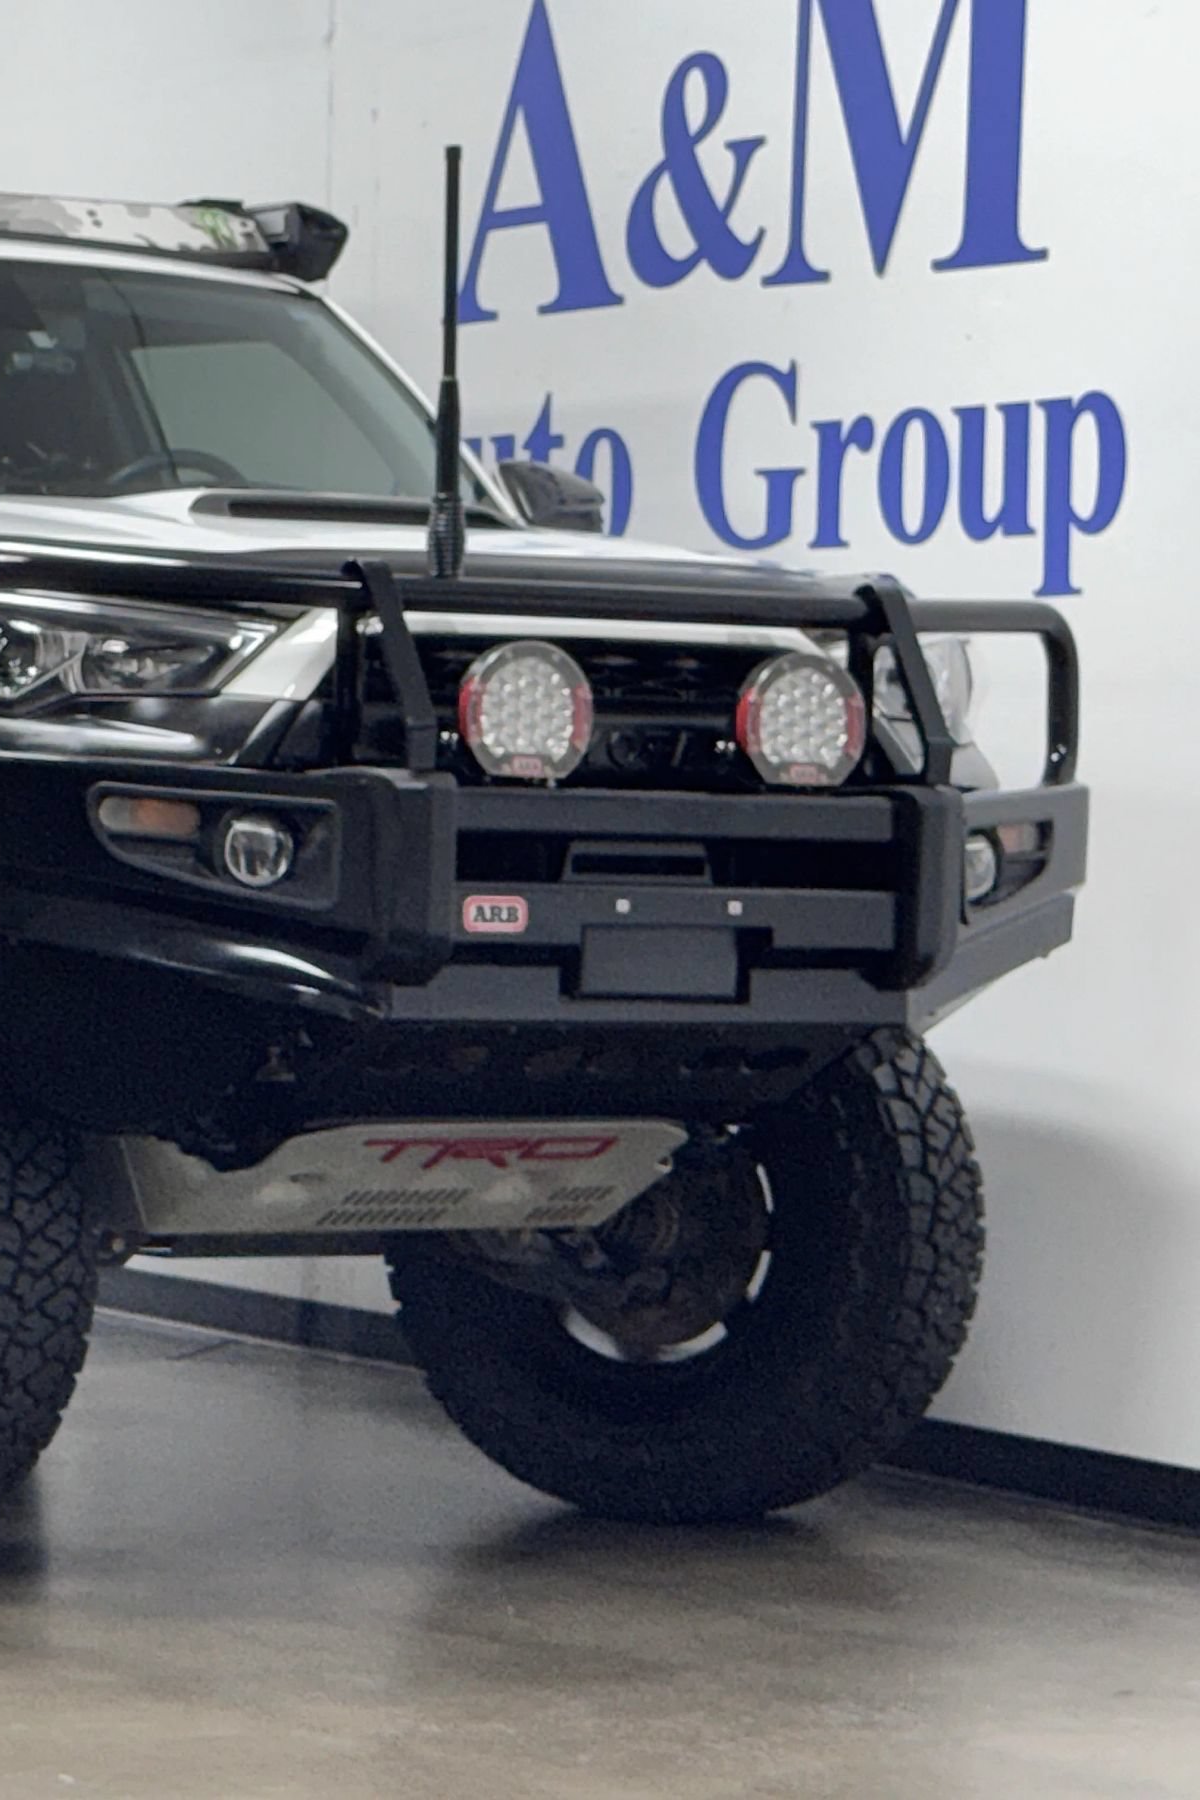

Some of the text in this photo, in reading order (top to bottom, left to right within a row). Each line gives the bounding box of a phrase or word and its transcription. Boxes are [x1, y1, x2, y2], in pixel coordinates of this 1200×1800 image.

[456, 0, 1049, 325] A&M
[694, 359, 1127, 597] Group
[473, 905, 519, 923] ARB
